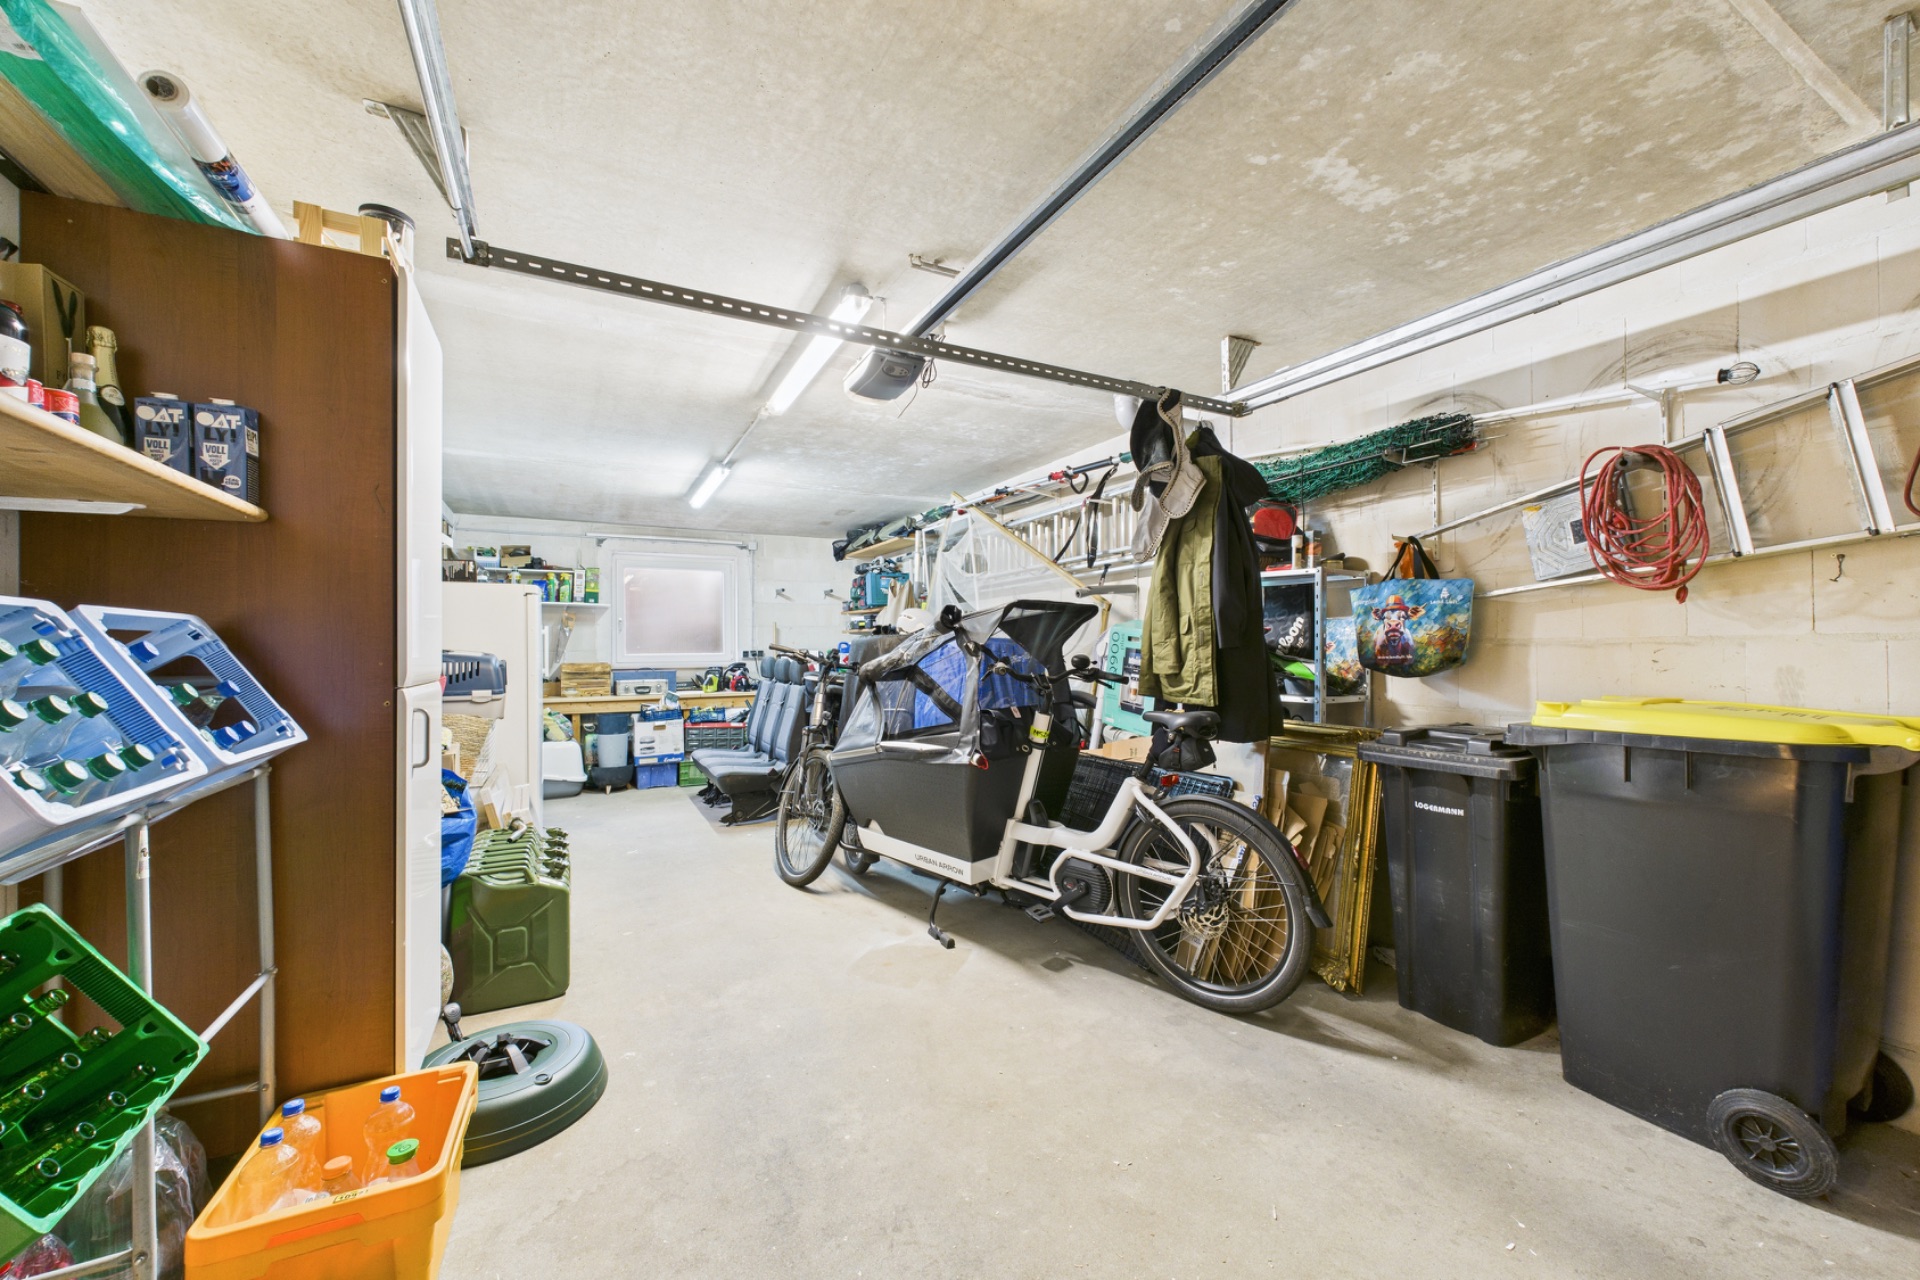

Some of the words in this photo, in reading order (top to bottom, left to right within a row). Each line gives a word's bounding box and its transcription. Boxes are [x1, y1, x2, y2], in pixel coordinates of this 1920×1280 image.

[146, 438, 169, 450] VOLL
[205, 444, 227, 455] VOLL
[1414, 800, 1465, 817] LOGERMANN
[914, 853, 938, 867] URBAN
[938, 861, 964, 876] ARROW
